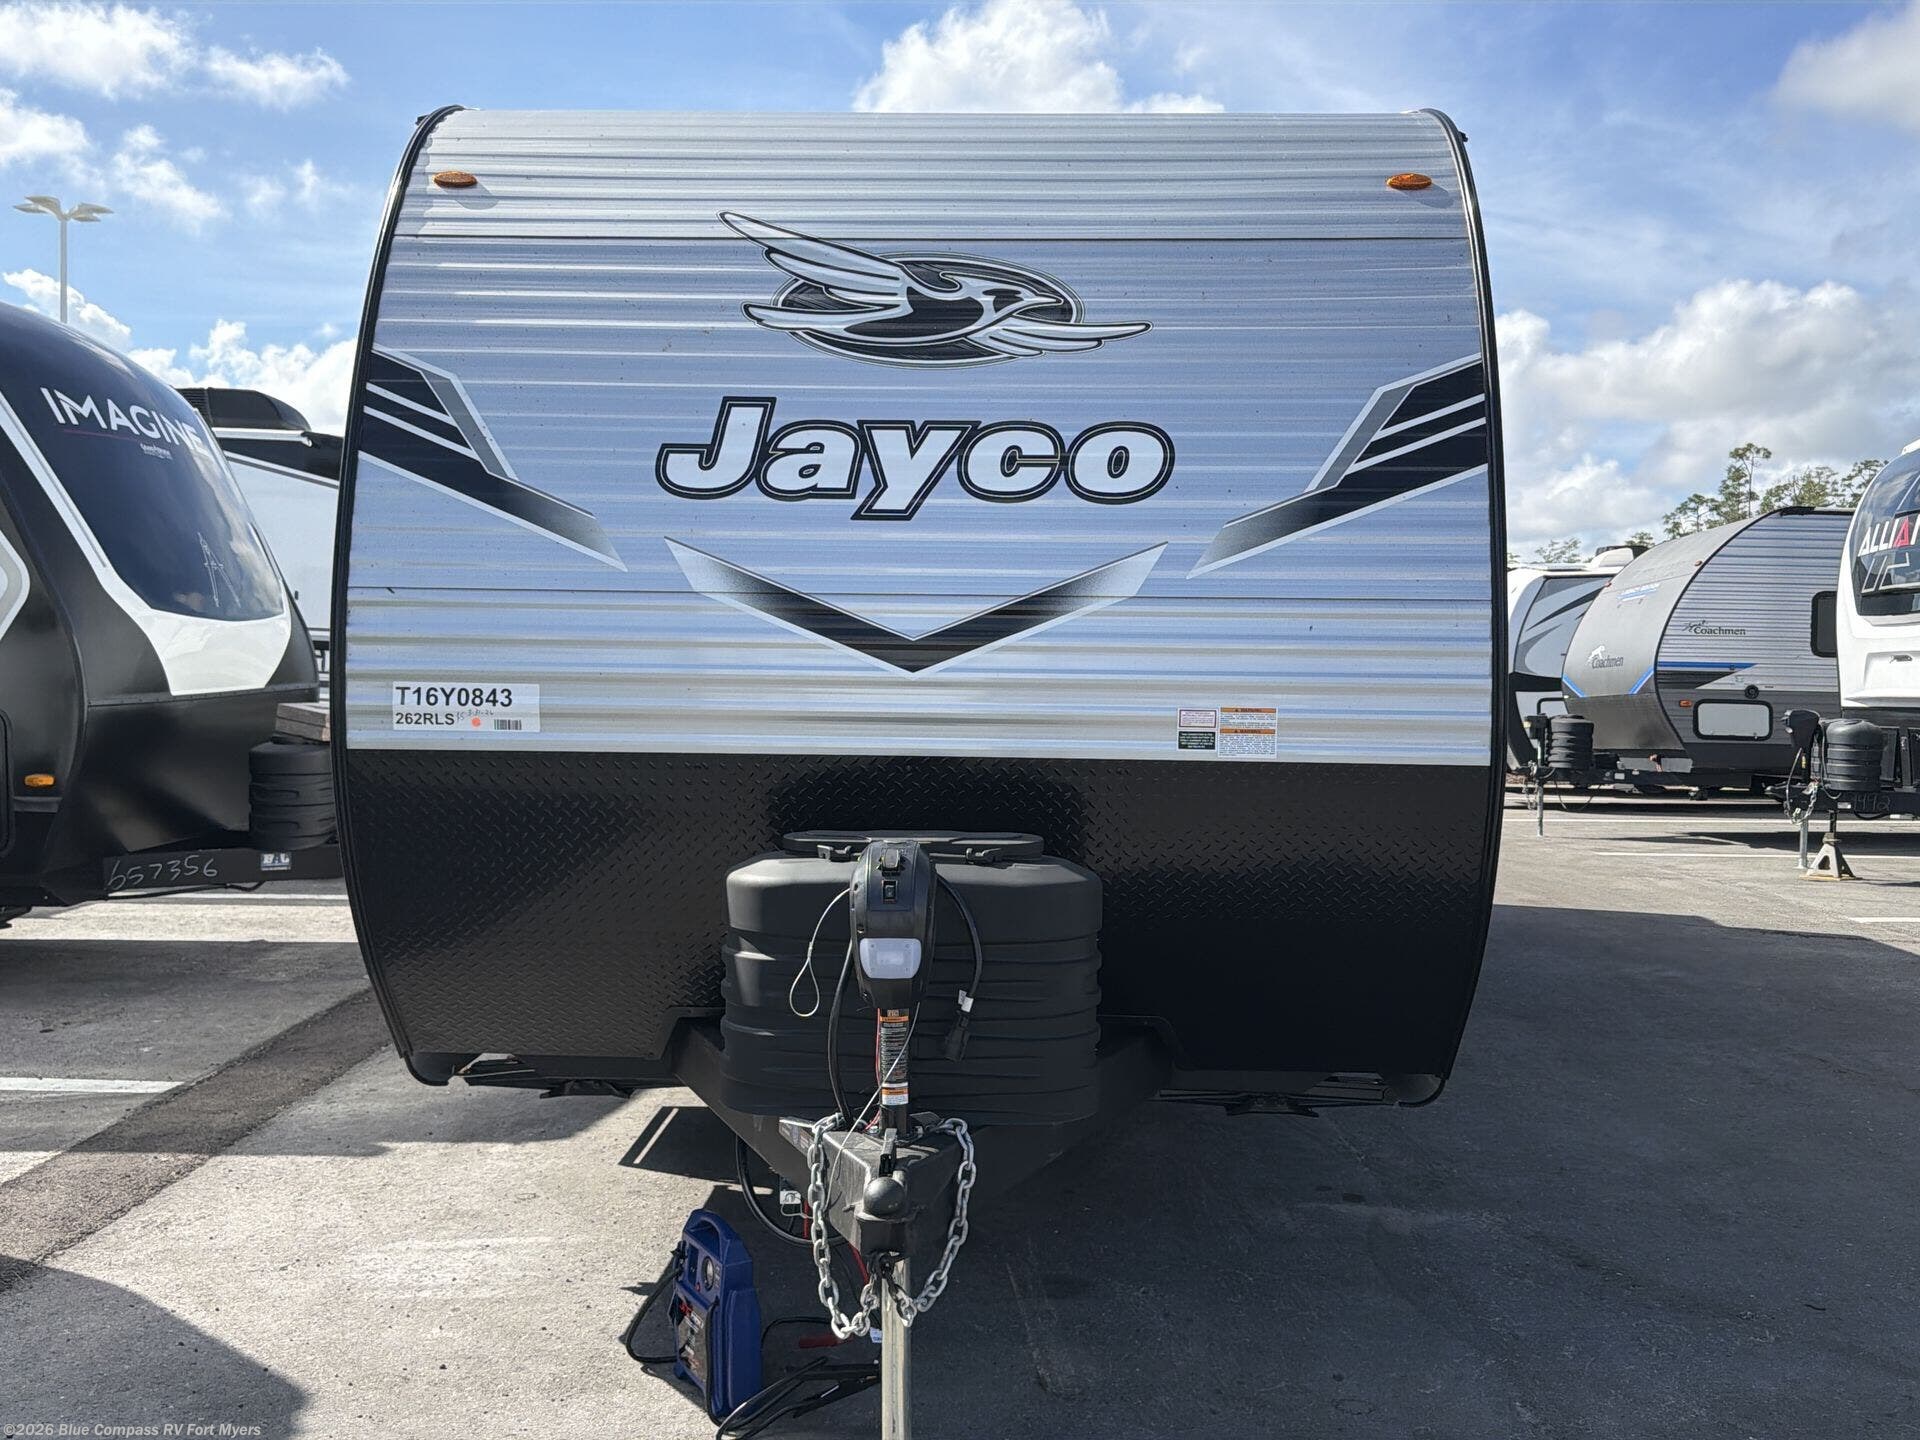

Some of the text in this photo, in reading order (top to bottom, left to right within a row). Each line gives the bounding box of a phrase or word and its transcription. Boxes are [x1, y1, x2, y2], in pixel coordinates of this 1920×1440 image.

[40, 387, 209, 457] IMAGINE
[655, 396, 1175, 521] Jayco
[1693, 625, 1747, 636] Coachmen
[1591, 655, 1624, 670] Coachmen
[395, 686, 513, 707] T16Y0843
[395, 712, 455, 726] 262RLS
[108, 855, 218, 890] 657356
